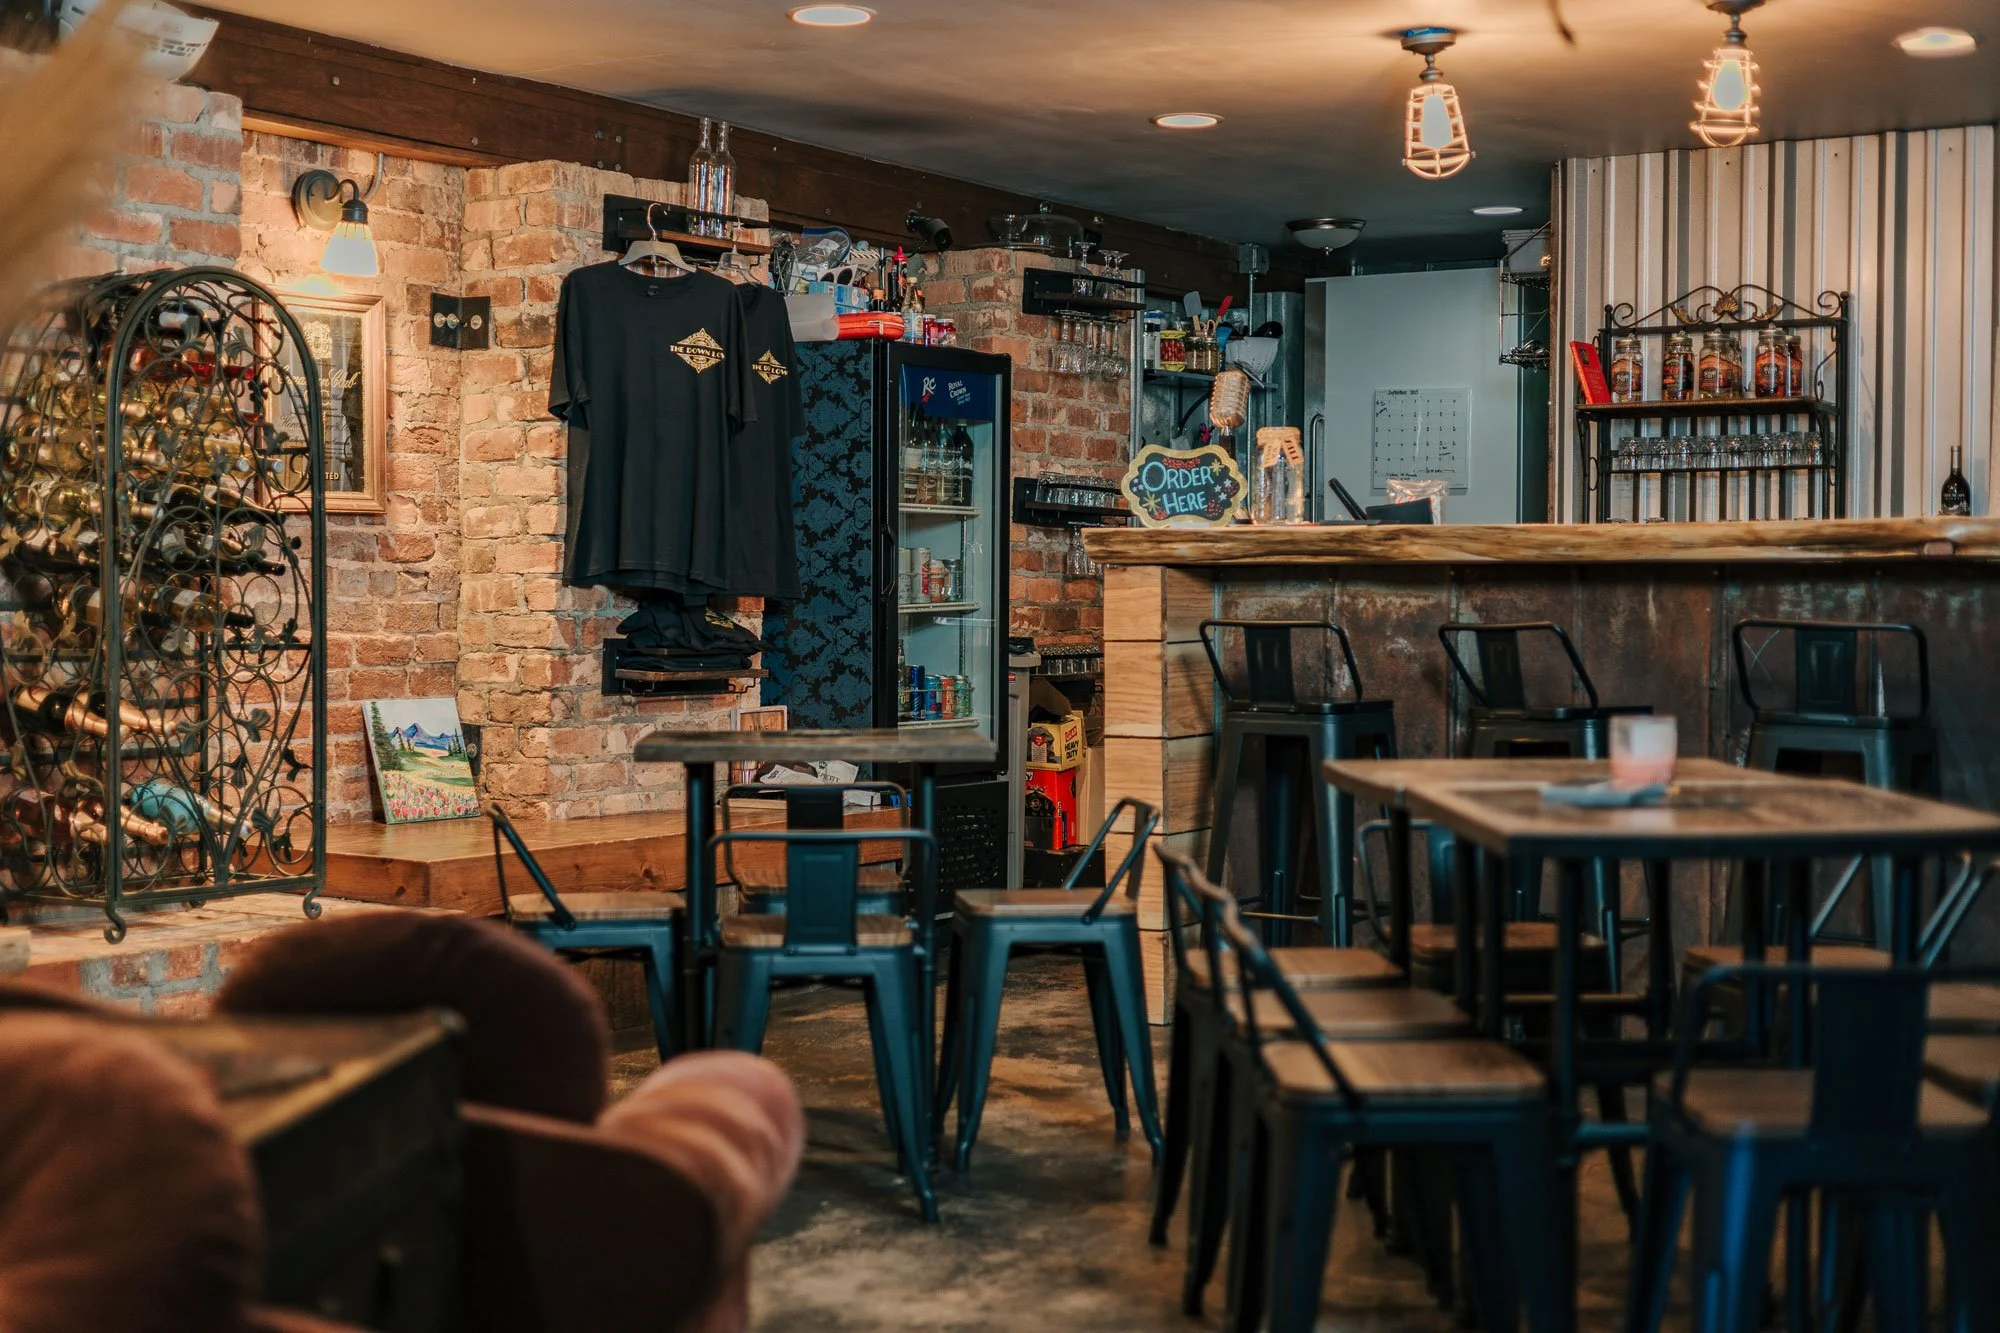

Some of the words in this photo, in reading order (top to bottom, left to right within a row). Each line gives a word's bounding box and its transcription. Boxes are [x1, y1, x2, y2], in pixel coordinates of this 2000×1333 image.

[670, 344, 684, 353] THE
[686, 346, 710, 356] DOWN
[771, 367, 788, 375] LOW
[922, 376, 937, 397] RC
[1142, 461, 1215, 492] ORDER
[1162, 491, 1208, 515] HERE
[1065, 740, 1080, 751] HEAVY
[1066, 749, 1078, 760] DUTY
